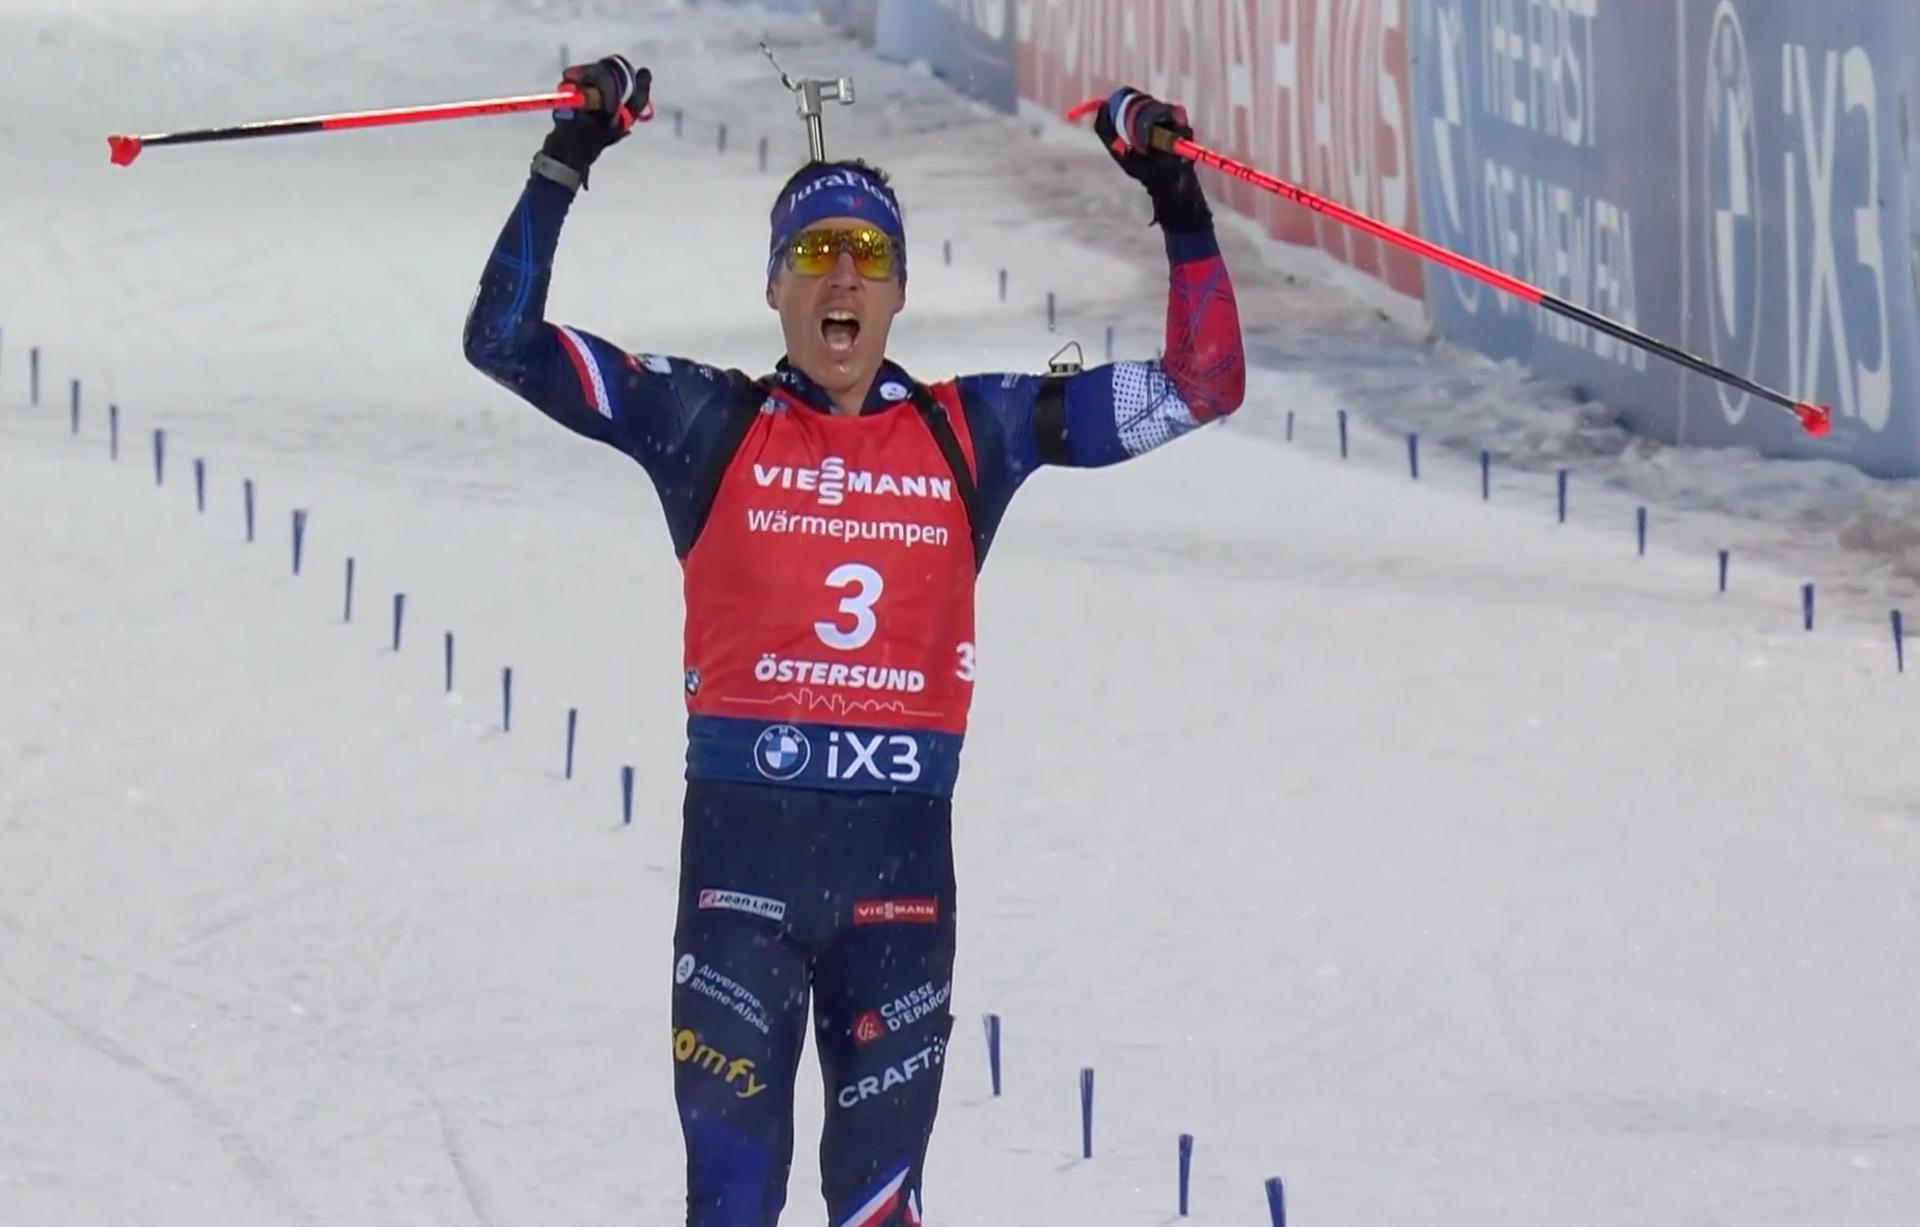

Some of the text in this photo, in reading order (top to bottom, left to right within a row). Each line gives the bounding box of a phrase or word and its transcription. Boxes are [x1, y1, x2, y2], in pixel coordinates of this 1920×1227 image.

[1782, 43, 1892, 431] iX3
[753, 456, 951, 506] VIESSMANN
[748, 508, 949, 547] Wärmepumpen
[814, 562, 885, 650] 3
[754, 653, 925, 692] ÖSTERSUND
[956, 641, 975, 681] 3
[827, 731, 922, 782] iX3
[858, 901, 935, 920] VIESSMANN
[880, 980, 935, 1018] CAISSE
[673, 1028, 768, 1098] omfy
[838, 1047, 932, 1108] CRAFT
